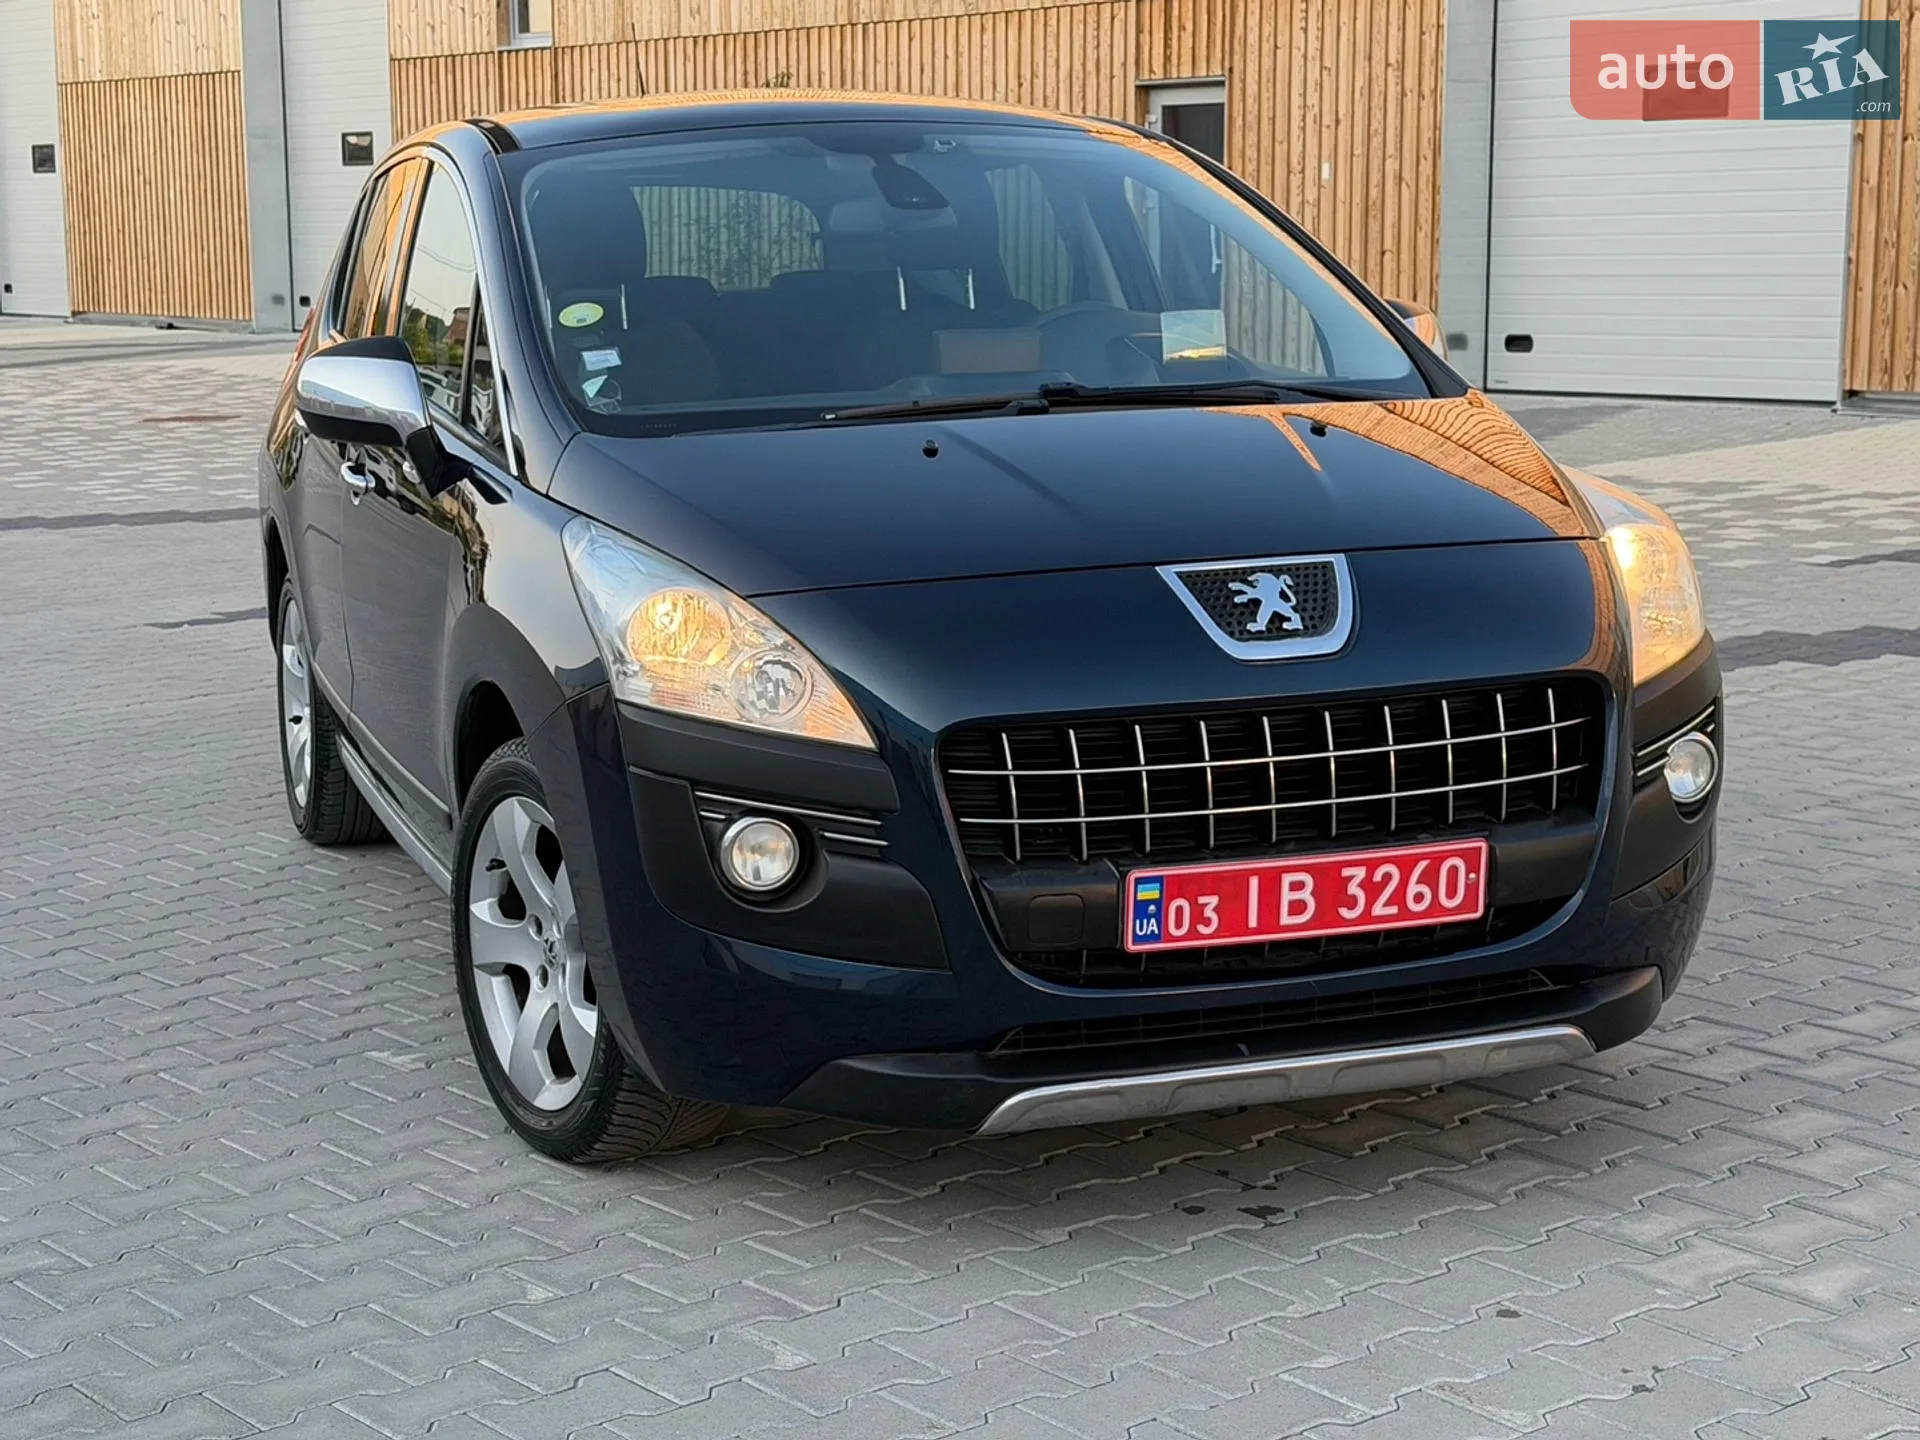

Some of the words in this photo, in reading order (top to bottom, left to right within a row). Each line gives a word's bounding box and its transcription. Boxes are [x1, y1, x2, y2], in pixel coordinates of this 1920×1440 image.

[1168, 896, 1220, 937] 03
[1337, 856, 1466, 920] 3260
[1135, 918, 1159, 936] UA
